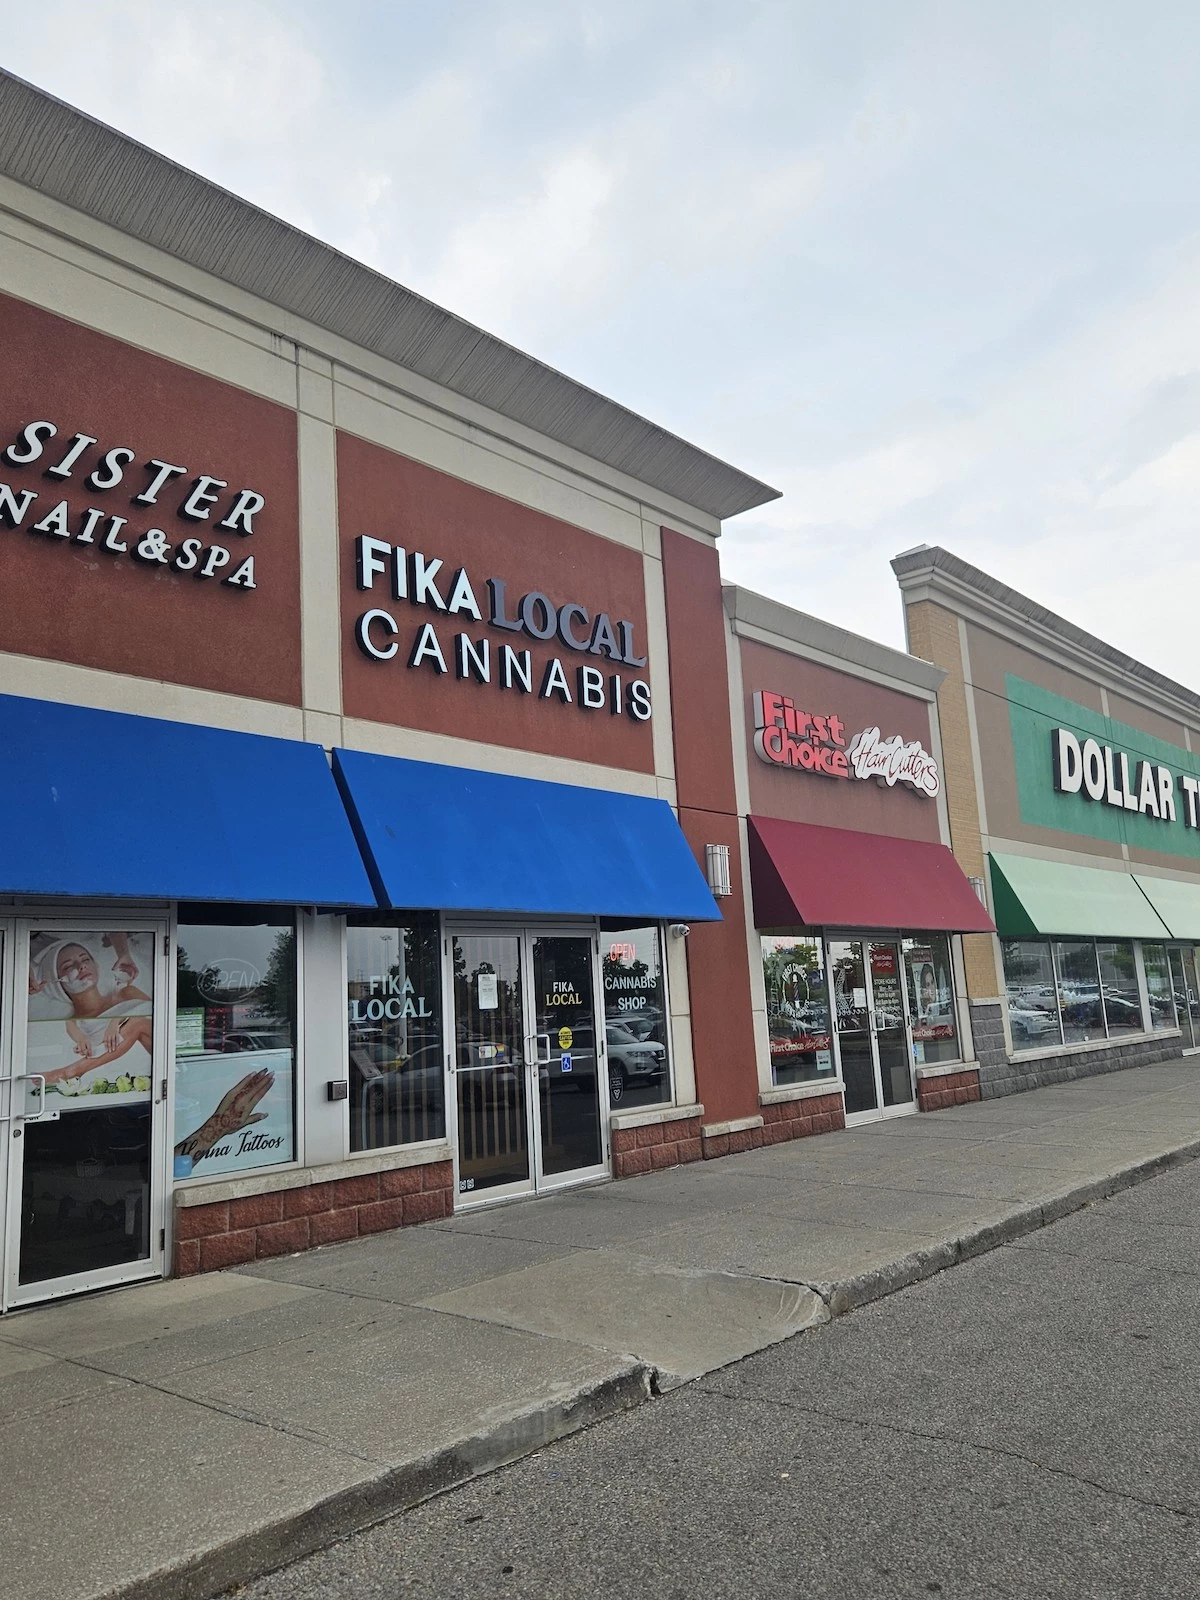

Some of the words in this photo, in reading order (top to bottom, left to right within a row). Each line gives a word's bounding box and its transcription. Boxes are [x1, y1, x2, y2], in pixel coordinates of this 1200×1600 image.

[4, 420, 266, 535] SISTER
[0, 483, 258, 590] NAIL&SPA
[355, 534, 482, 621] FIKA
[486, 577, 648, 668] LOCAL
[355, 608, 652, 722] CANNABIS
[753, 690, 846, 747] First
[754, 724, 849, 779] Choice
[1051, 727, 1177, 823] DOLLAR
[1177, 775, 1200, 830] T
[610, 943, 637, 962] OPEN
[201, 970, 255, 993] OPEN
[369, 974, 415, 996] FIKA
[553, 981, 575, 993] FIKA
[605, 976, 657, 991] CANNABIS
[351, 996, 433, 1021] LOCAL
[546, 993, 583, 1006] LOCAL
[618, 996, 647, 1011] SHOP
[770, 1042, 785, 1053] First
[785, 1041, 805, 1052] Choice
[235, 1130, 285, 1157] Tattoos
